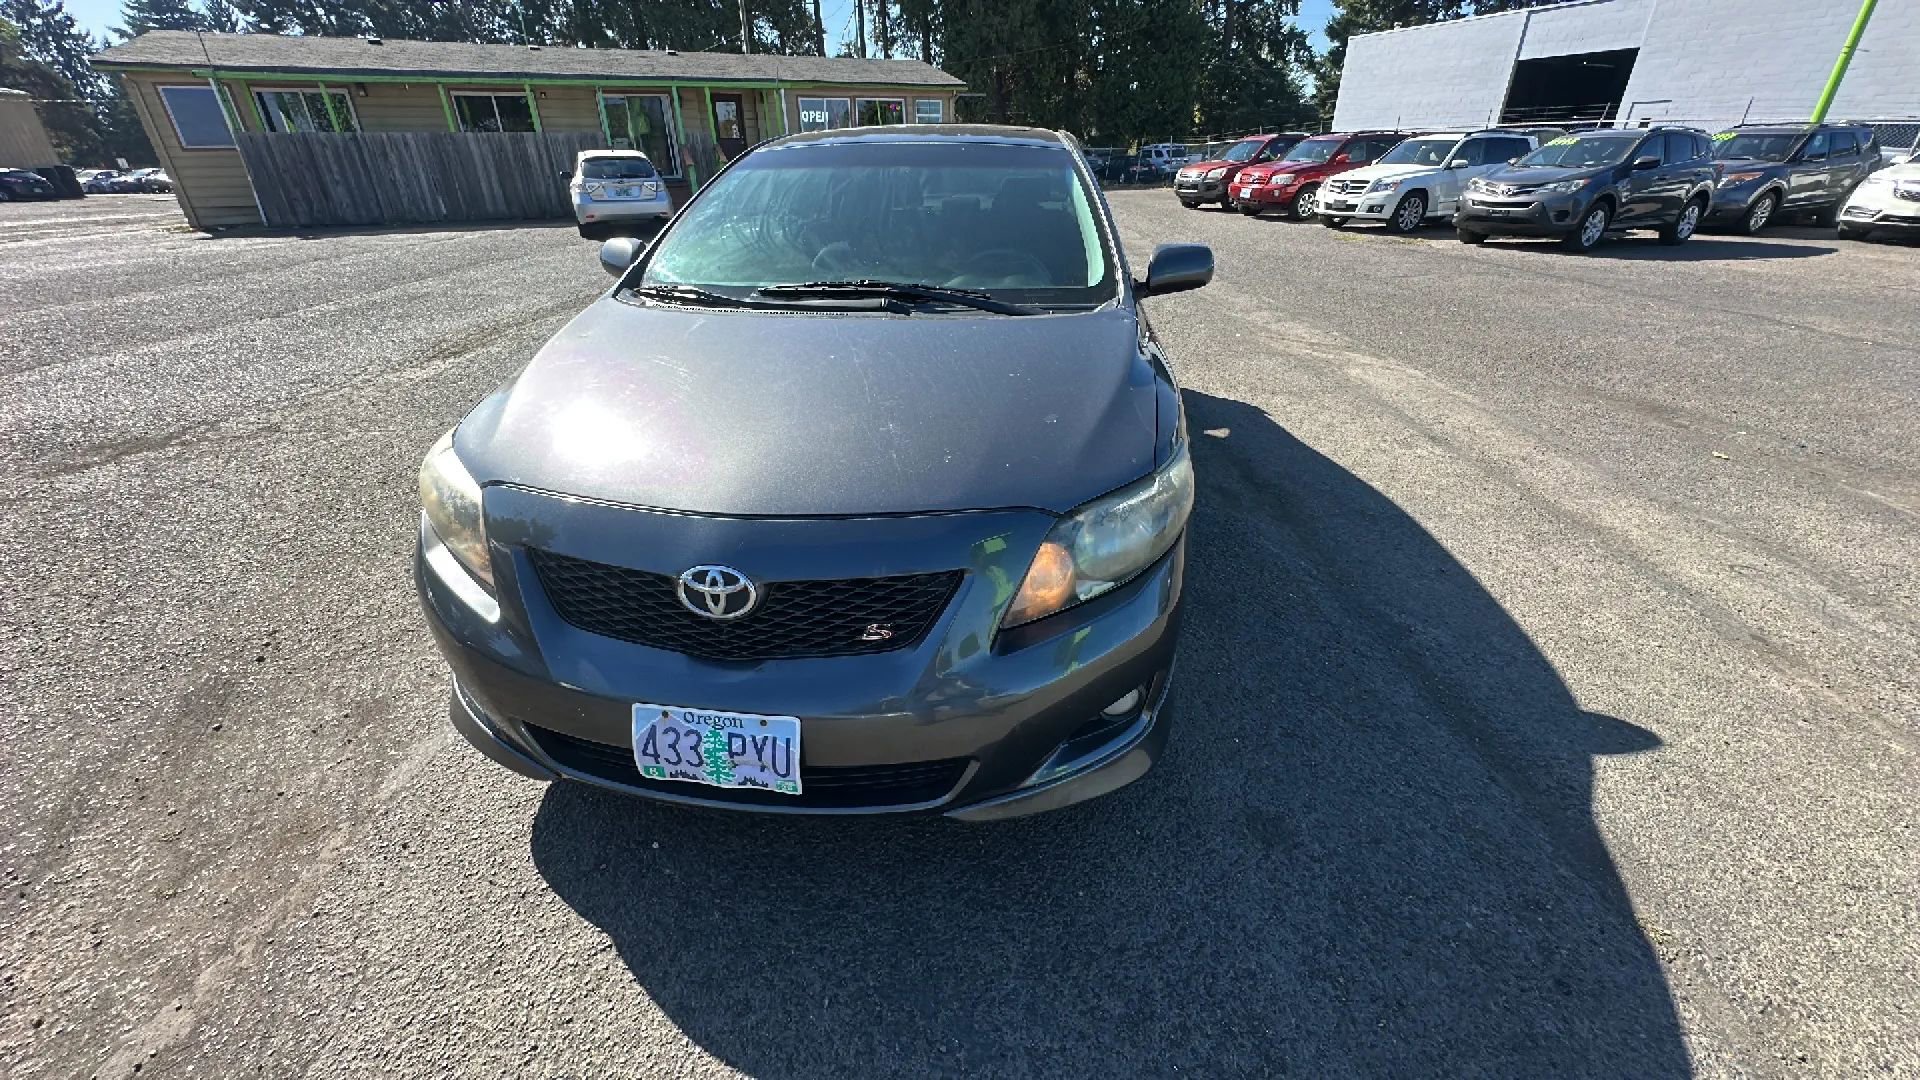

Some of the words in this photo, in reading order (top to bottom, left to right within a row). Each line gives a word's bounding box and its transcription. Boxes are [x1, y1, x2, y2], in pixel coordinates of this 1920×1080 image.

[801, 110, 828, 123] OPEN
[683, 711, 744, 729] Oregon
[642, 724, 704, 767] 433
[728, 732, 791, 779] PYU
